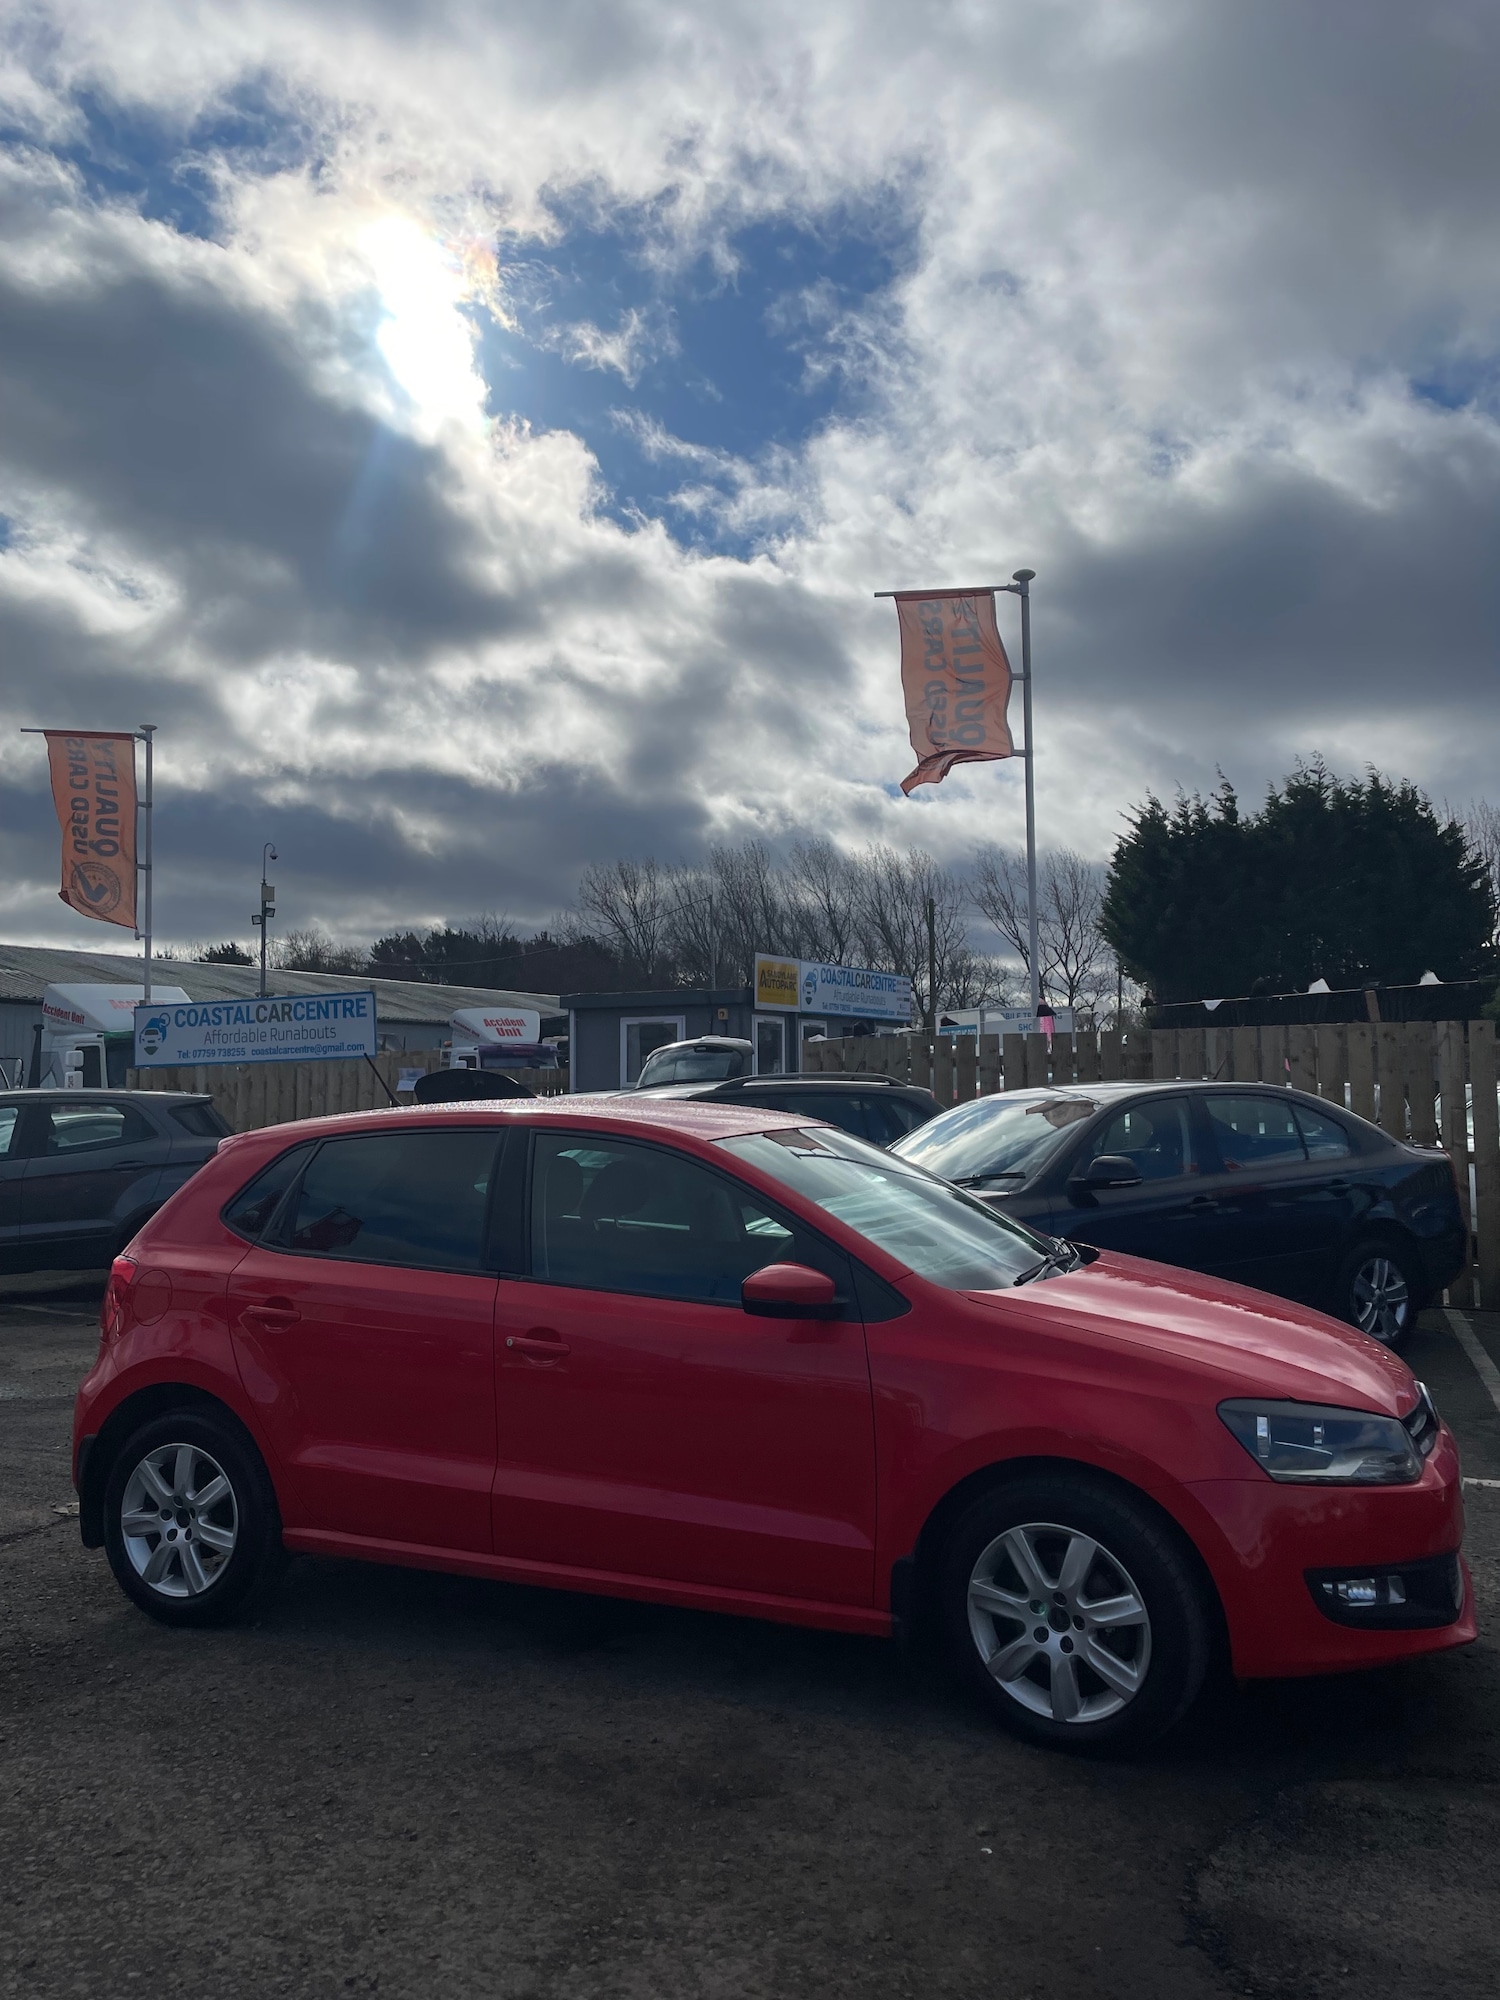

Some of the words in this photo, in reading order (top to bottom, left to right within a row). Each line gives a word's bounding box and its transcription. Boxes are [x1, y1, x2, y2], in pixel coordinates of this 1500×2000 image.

[820, 968, 897, 993] COASTALCARCENTRE
[43, 1003, 71, 1021] Accident
[71, 1013, 86, 1025] Unit
[174, 998, 367, 1026] COASTALCARCENTRE
[483, 1018, 527, 1028] Accident
[495, 1027, 523, 1037] Unit
[204, 1028, 267, 1044] Affordable
[270, 1024, 337, 1041] Runabouts
[177, 1050, 191, 1059] Tel:
[192, 1049, 216, 1059] 07759
[217, 1047, 246, 1058] 738255
[251, 1042, 365, 1057] coastalcarcentre@gmail.com
